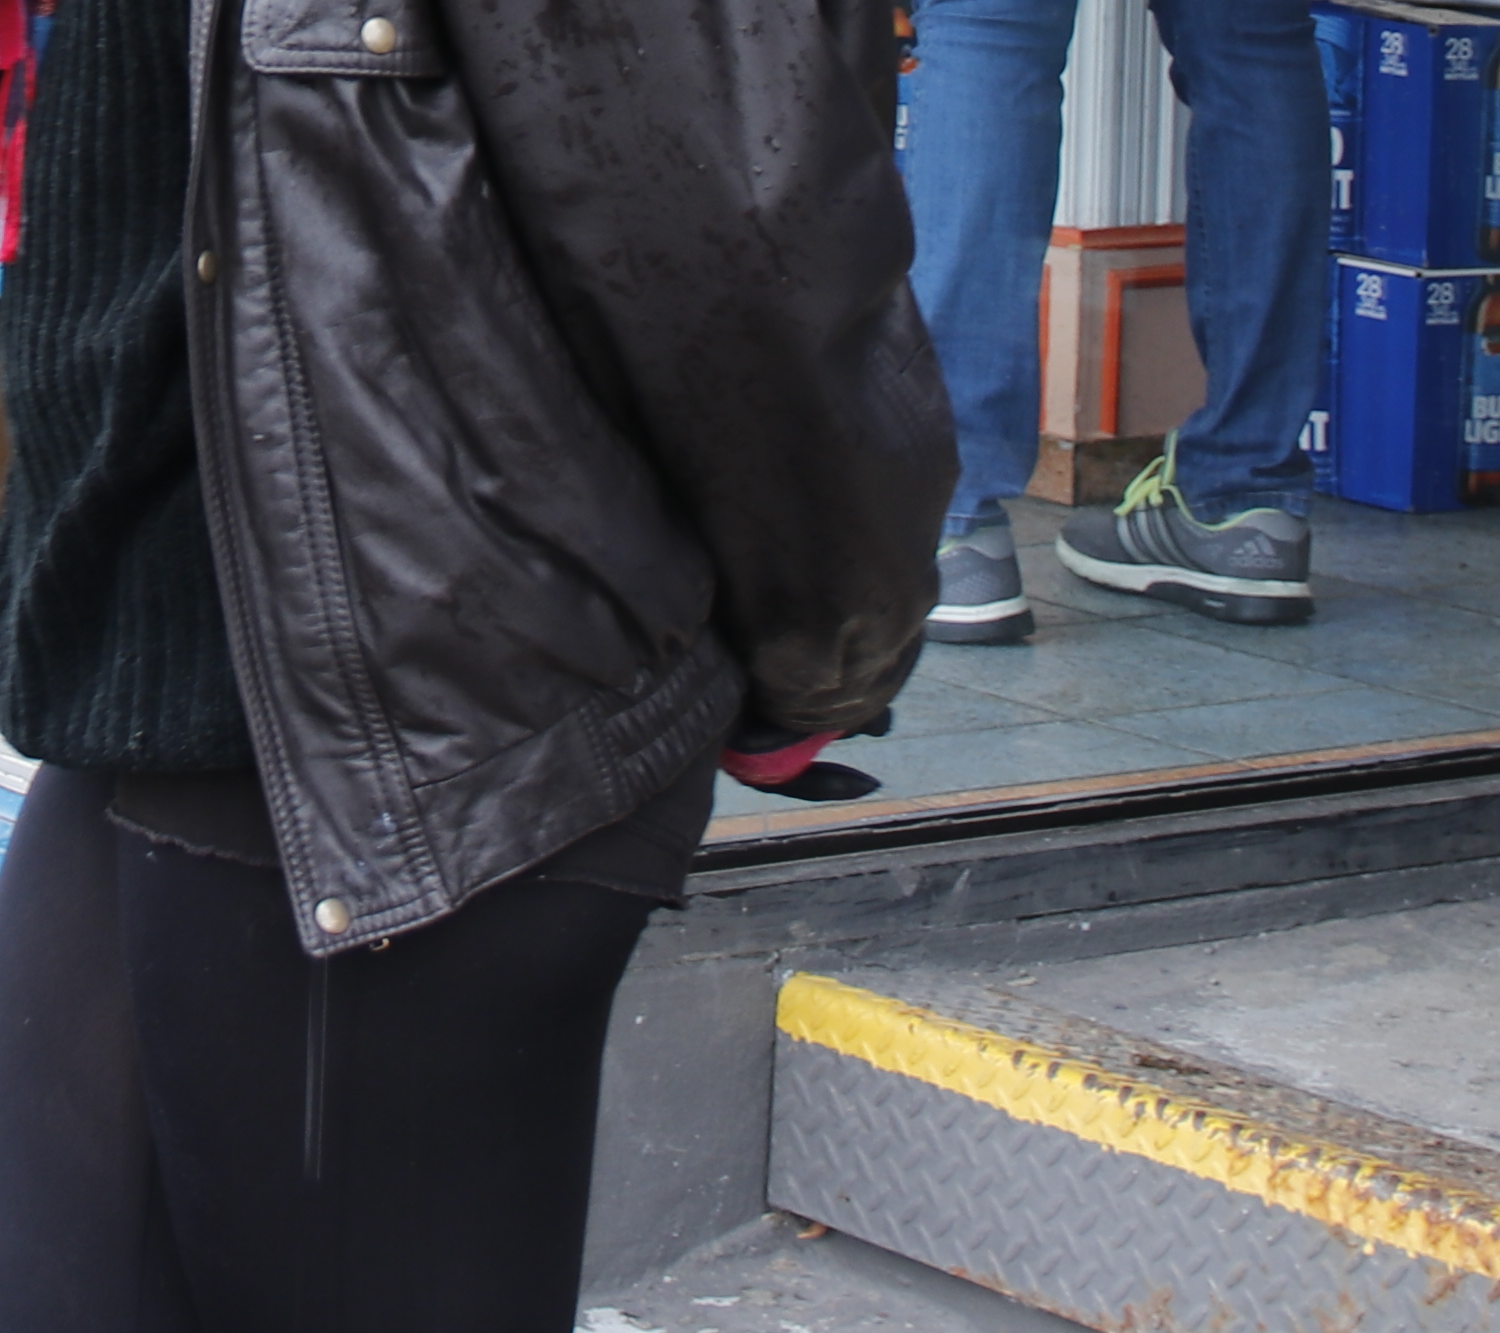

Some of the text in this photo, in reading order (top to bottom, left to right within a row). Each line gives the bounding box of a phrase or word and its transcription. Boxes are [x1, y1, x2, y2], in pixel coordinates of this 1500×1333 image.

[1380, 31, 1404, 56] 28
[1445, 37, 1473, 61] 28
[1356, 273, 1382, 297] 28
[1427, 283, 1454, 305] 28
[1230, 554, 1284, 570] adidas
